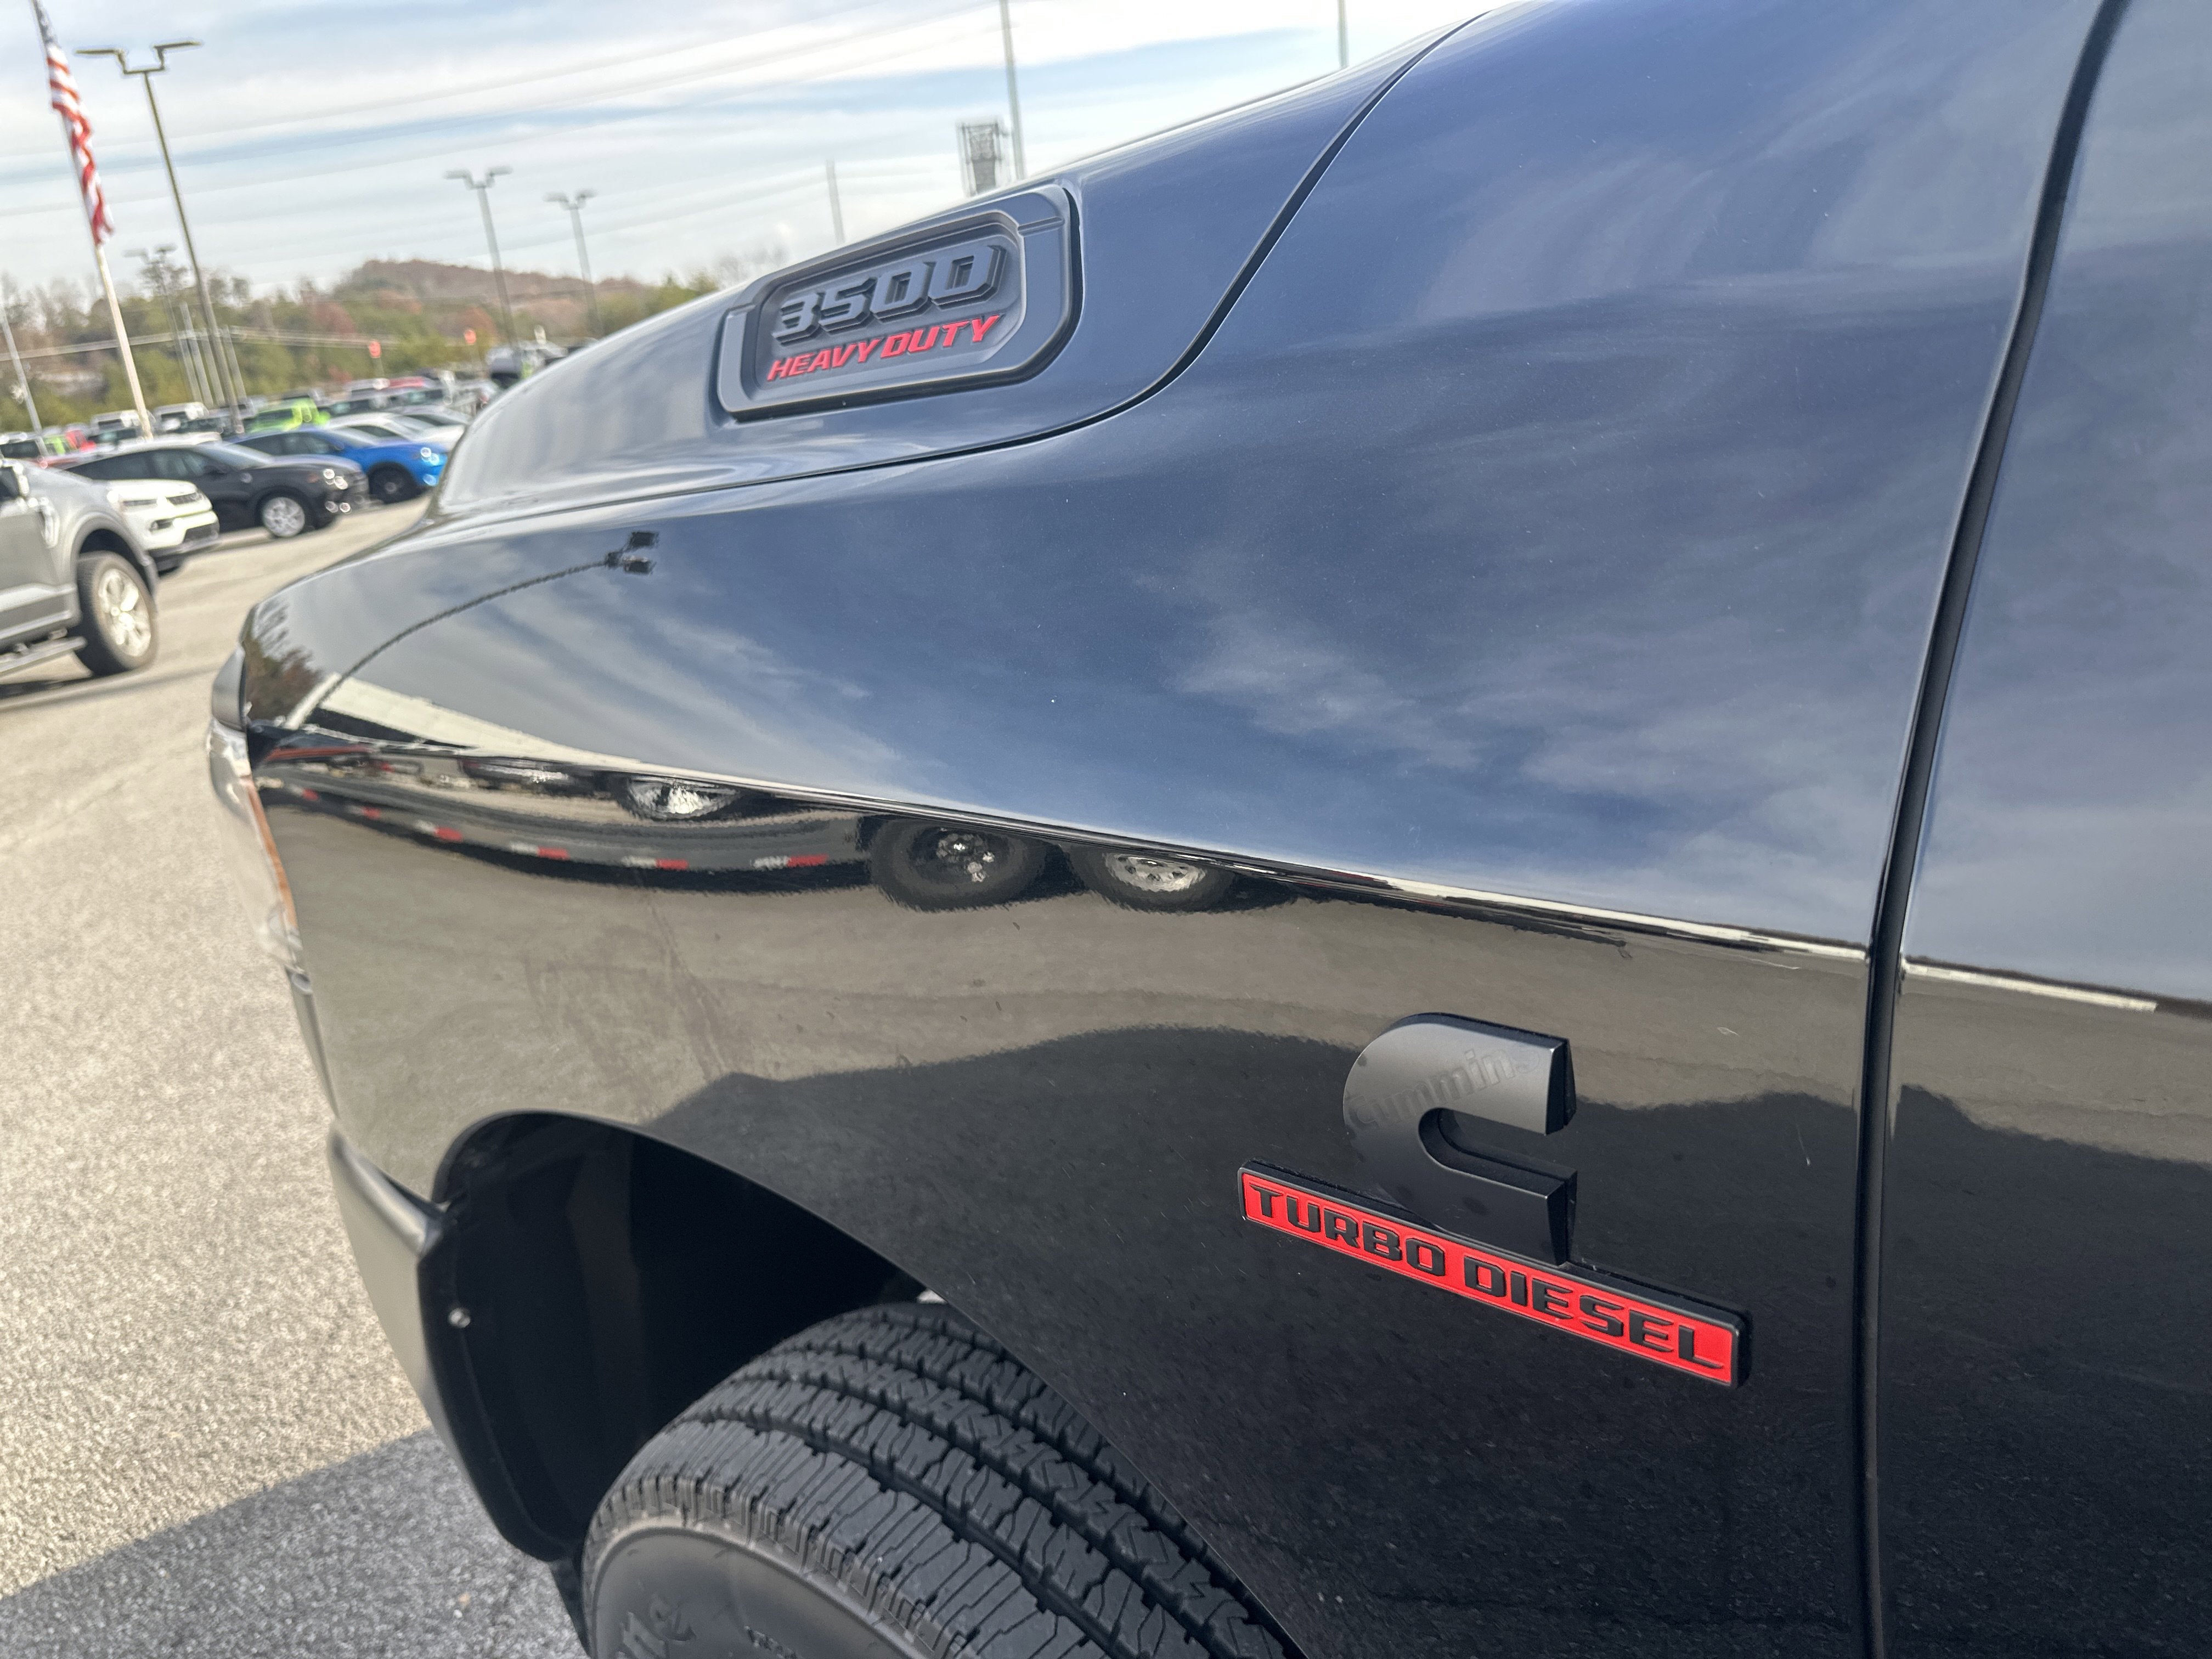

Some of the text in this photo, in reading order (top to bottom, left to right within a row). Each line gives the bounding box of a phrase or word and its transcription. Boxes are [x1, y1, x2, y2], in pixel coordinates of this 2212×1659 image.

[772, 245, 1006, 346] 3500
[768, 315, 1000, 381] HEAVY DUTY
[1249, 1183, 1724, 1369] TURBO DIESEL
